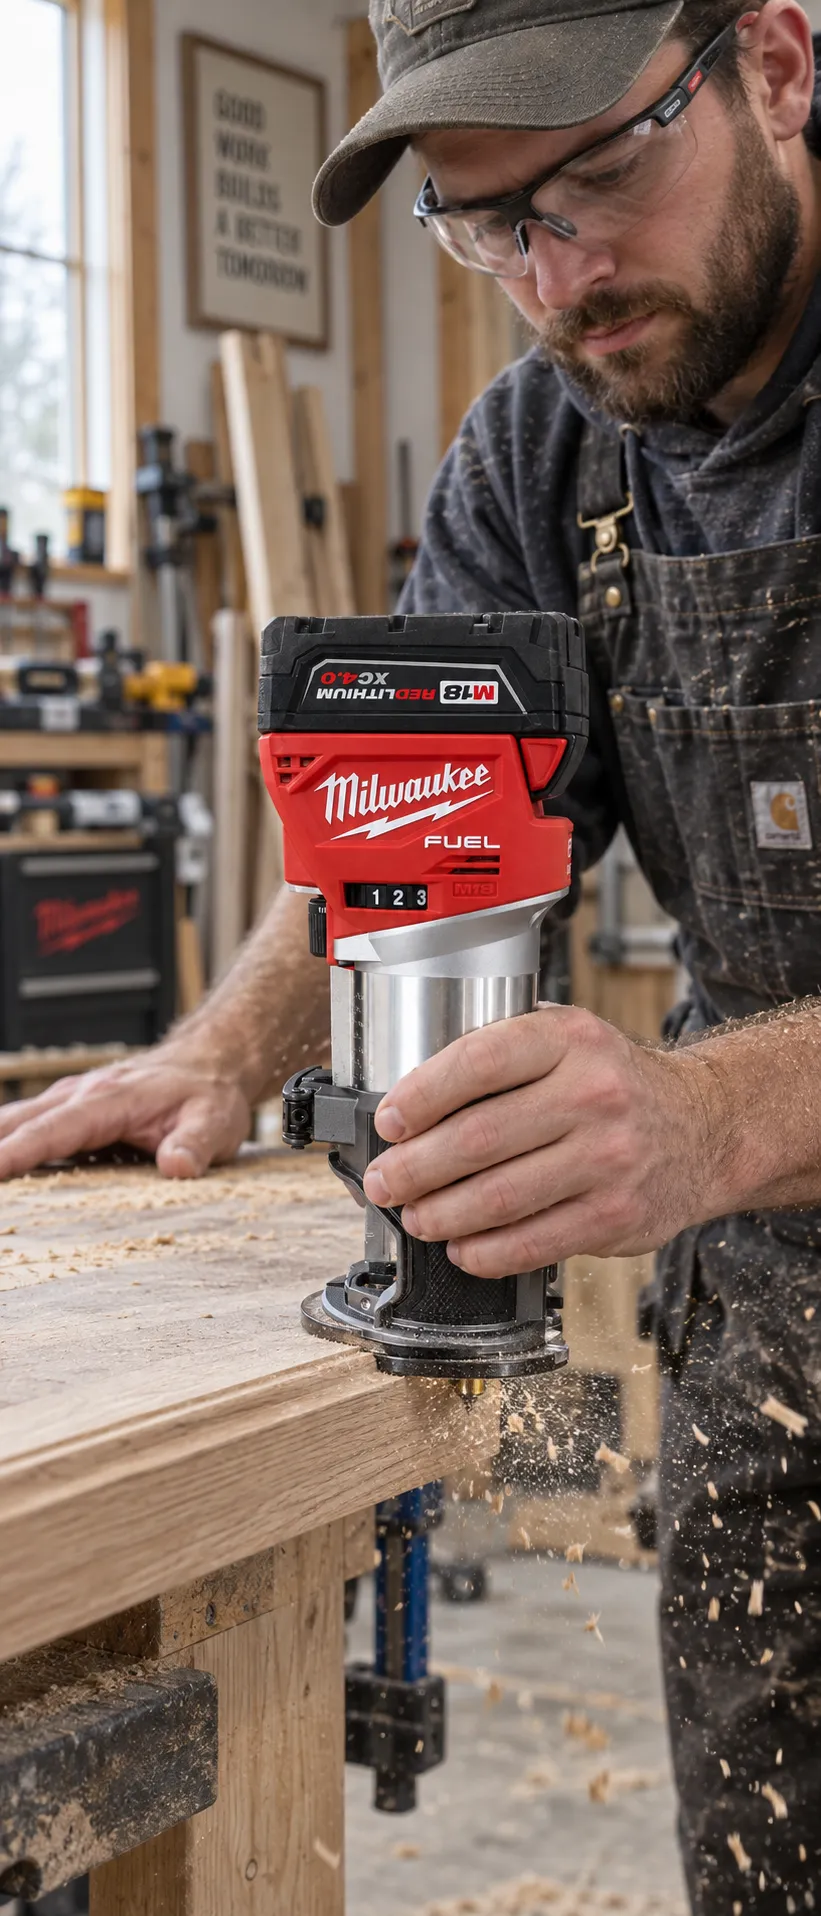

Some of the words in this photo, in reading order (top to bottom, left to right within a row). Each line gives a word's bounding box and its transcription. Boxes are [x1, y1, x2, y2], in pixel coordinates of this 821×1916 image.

[214, 89, 266, 132] GOOD
[214, 130, 270, 171] WORK
[215, 169, 281, 214] BUILDS
[215, 208, 230, 236] A
[235, 213, 302, 256] BETTER
[320, 671, 390, 685] XC4.0
[316, 688, 437, 700] REDLITHIUM
[443, 684, 495, 700] M18
[314, 762, 492, 825] Milwaukee
[424, 836, 500, 849] FUEL
[372, 888, 379, 905] 1
[393, 889, 403, 906] 2
[417, 889, 426, 906] 3
[454, 883, 494, 896] M18
